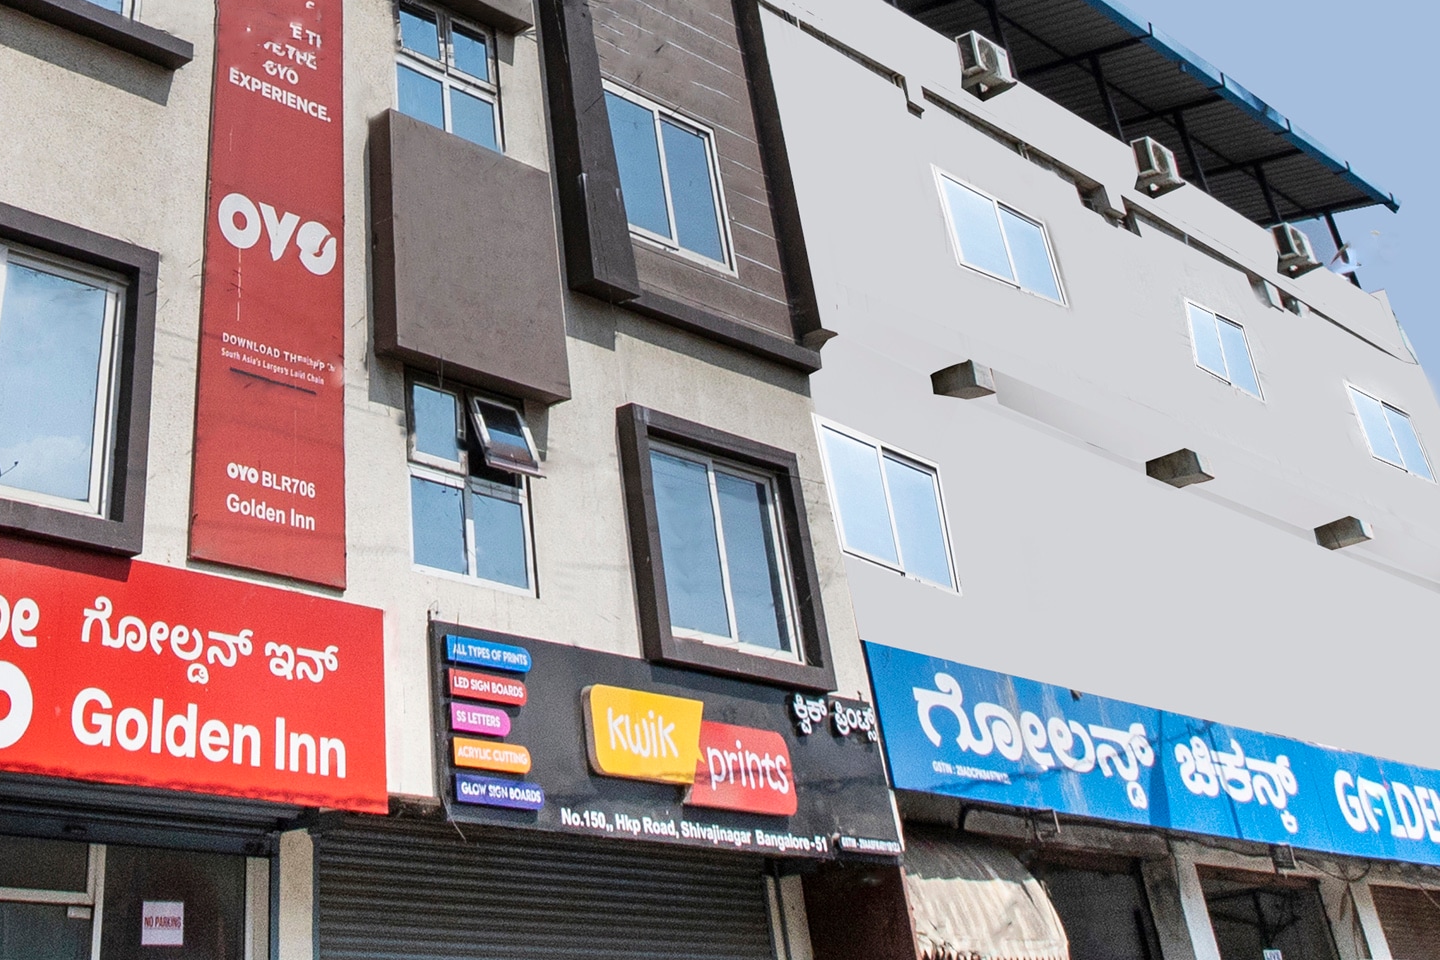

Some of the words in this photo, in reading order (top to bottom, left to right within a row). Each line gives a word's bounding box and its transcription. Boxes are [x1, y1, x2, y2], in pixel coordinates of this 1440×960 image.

[217, 192, 337, 276] OYO
[222, 332, 280, 358] DOWNLOAD
[226, 462, 259, 484] OYO
[262, 470, 316, 498] BLR706
[226, 493, 286, 525] Golden
[290, 508, 316, 531] Inn
[468, 644, 490, 660] TYPES
[491, 649, 501, 661] OF
[503, 651, 528, 666] PRINTS
[453, 676, 469, 689] LED
[470, 679, 490, 692] SIGN
[491, 682, 524, 698] BOARDS
[456, 710, 466, 722] SS
[468, 712, 501, 728] LETTERS
[71, 687, 261, 767] Golden
[275, 716, 346, 779] Inn
[457, 746, 492, 760] ACRYLIC
[492, 749, 528, 765] CUTTING
[706, 740, 790, 795] prints
[461, 781, 486, 796] GLOW
[488, 784, 508, 799] SIGN
[509, 787, 542, 803] BOARDS
[615, 813, 641, 837] Hkp
[642, 817, 680, 839] Road,
[681, 820, 752, 847] Shivajinagar
[144, 916, 153, 928] NO
[155, 916, 182, 928] PARKING
